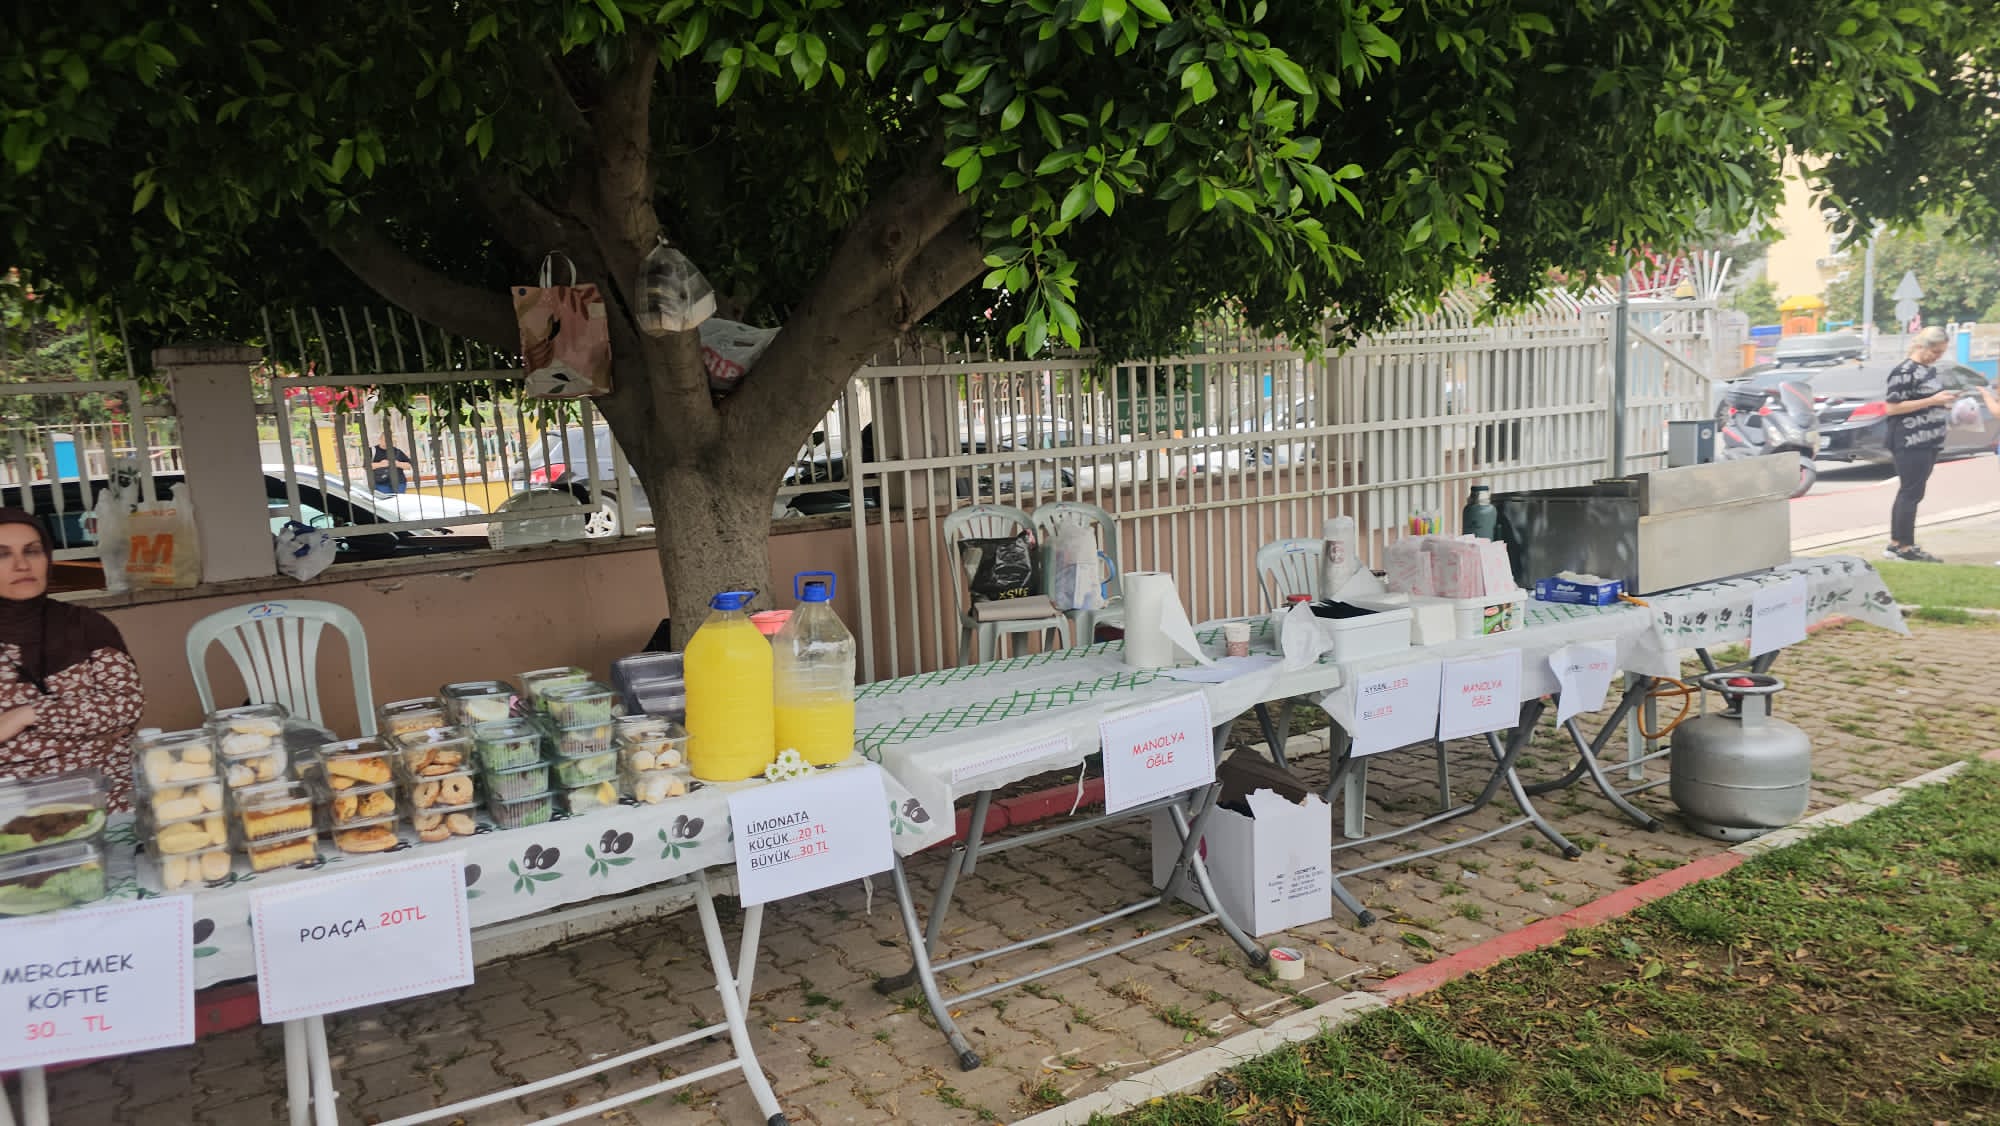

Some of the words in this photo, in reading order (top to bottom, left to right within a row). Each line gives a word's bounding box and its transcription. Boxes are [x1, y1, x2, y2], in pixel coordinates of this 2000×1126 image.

[1133, 731, 1185, 756] MANOLYA
[747, 811, 809, 834] LİMONATA
[814, 824, 827, 835] TL
[816, 841, 829, 852] TL
[2, 953, 134, 984] MERCİMEK
[28, 985, 109, 1012] KÖFTE
[82, 1014, 113, 1033] TL
